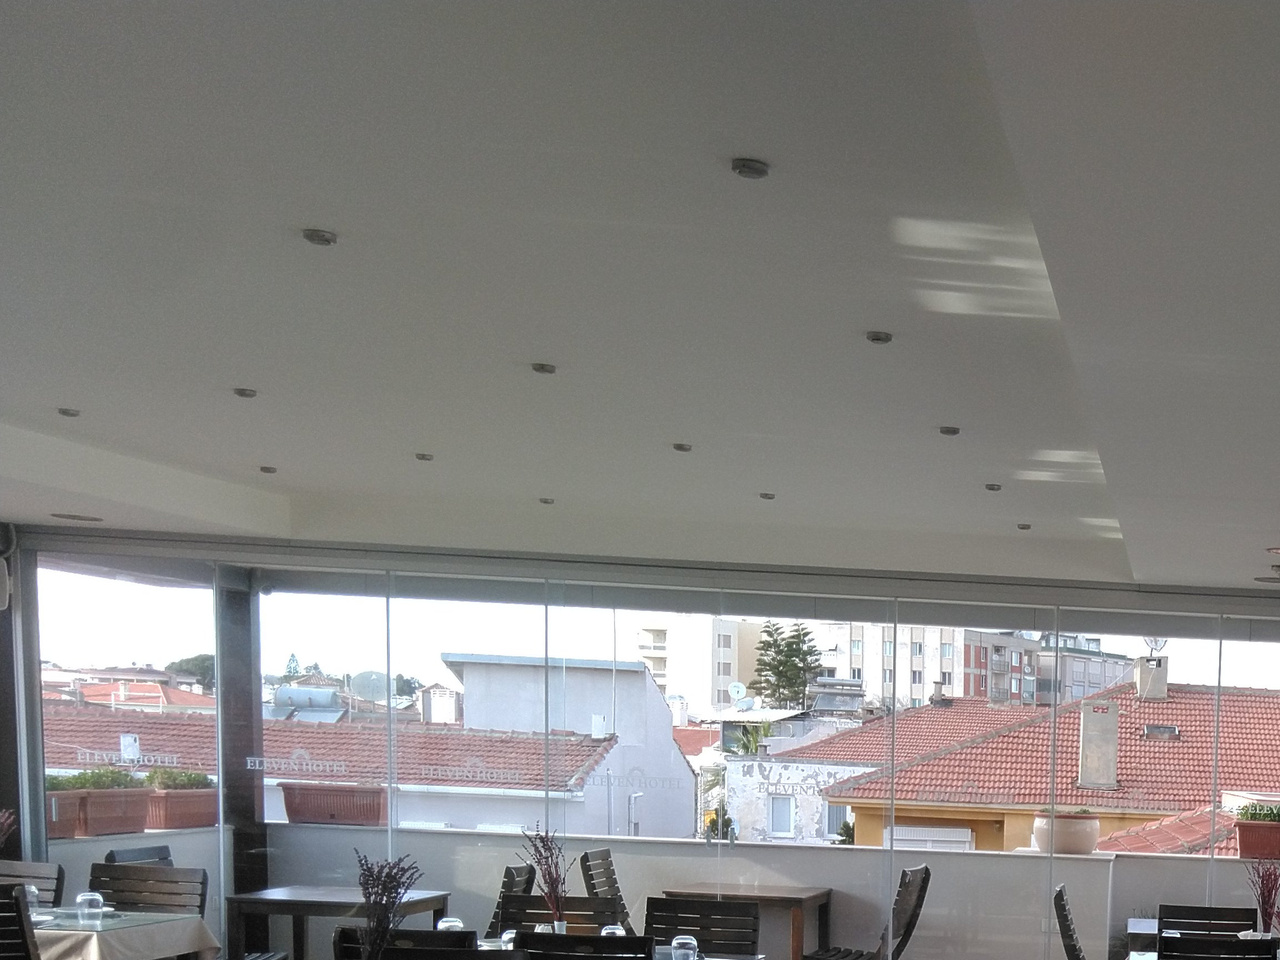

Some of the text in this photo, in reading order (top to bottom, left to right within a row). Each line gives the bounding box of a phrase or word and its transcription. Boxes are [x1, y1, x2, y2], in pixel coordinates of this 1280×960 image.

[246, 759, 348, 774] ELEVEN HOTEL
[421, 767, 520, 781] ELEVEN HOTEL
[586, 776, 683, 790] ELEVEN HOTEL
[758, 782, 809, 796] ELEVEN
